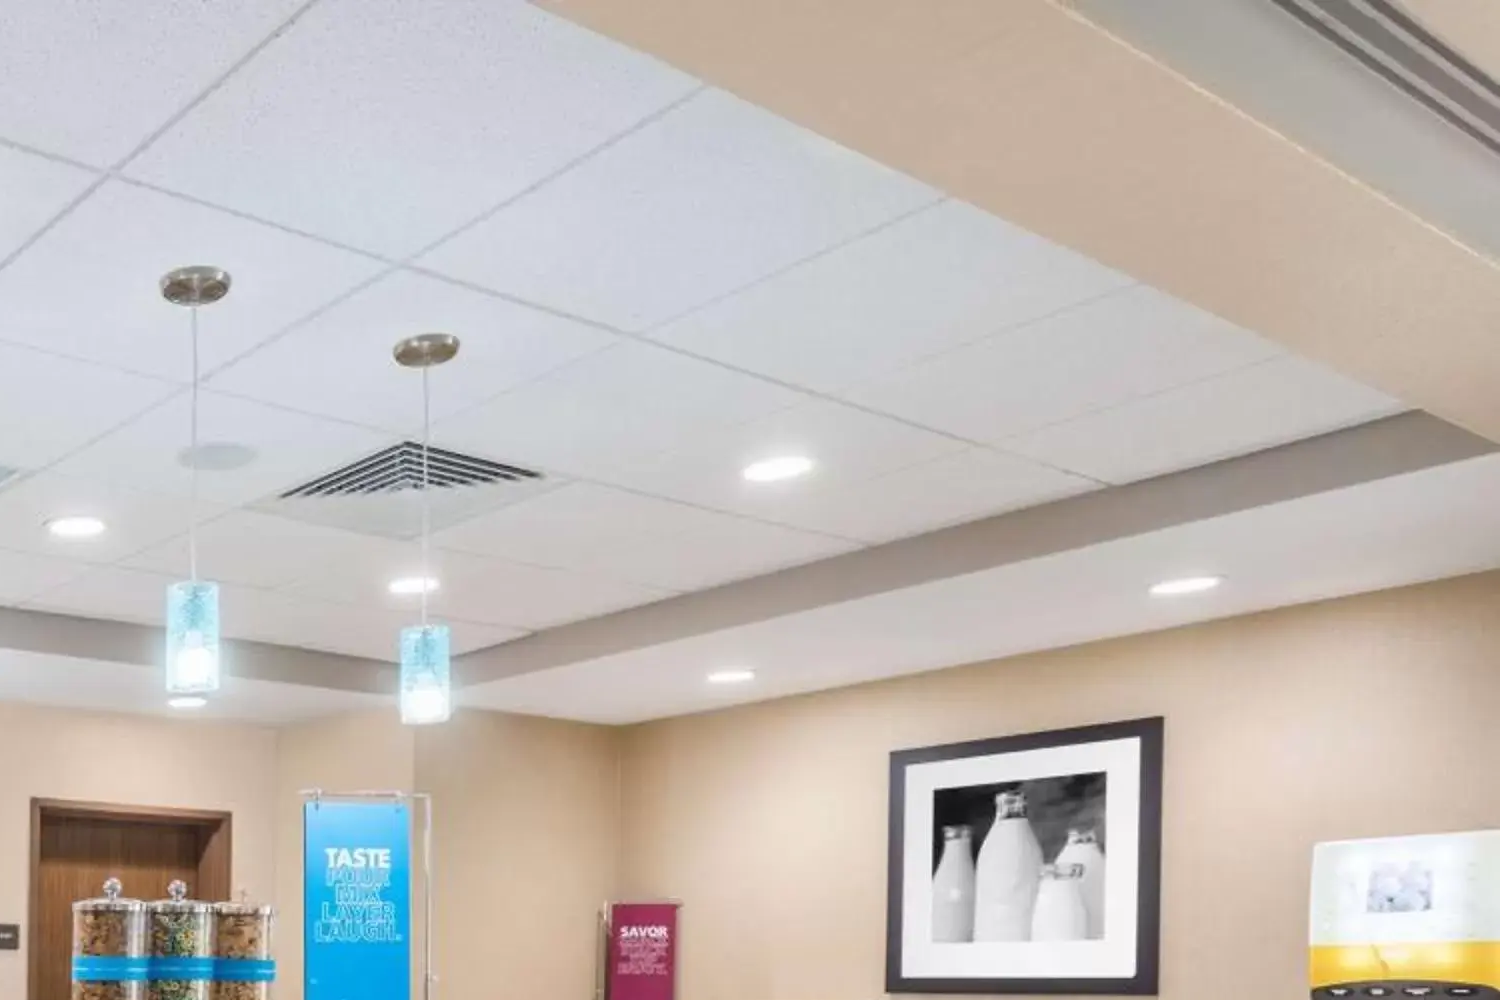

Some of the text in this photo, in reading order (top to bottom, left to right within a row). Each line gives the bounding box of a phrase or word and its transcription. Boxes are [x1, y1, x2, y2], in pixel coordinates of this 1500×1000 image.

[324, 847, 390, 869] TASTE
[321, 901, 395, 922] LAYER
[314, 921, 402, 942] LAUGH.
[620, 925, 669, 938] SAVOR
